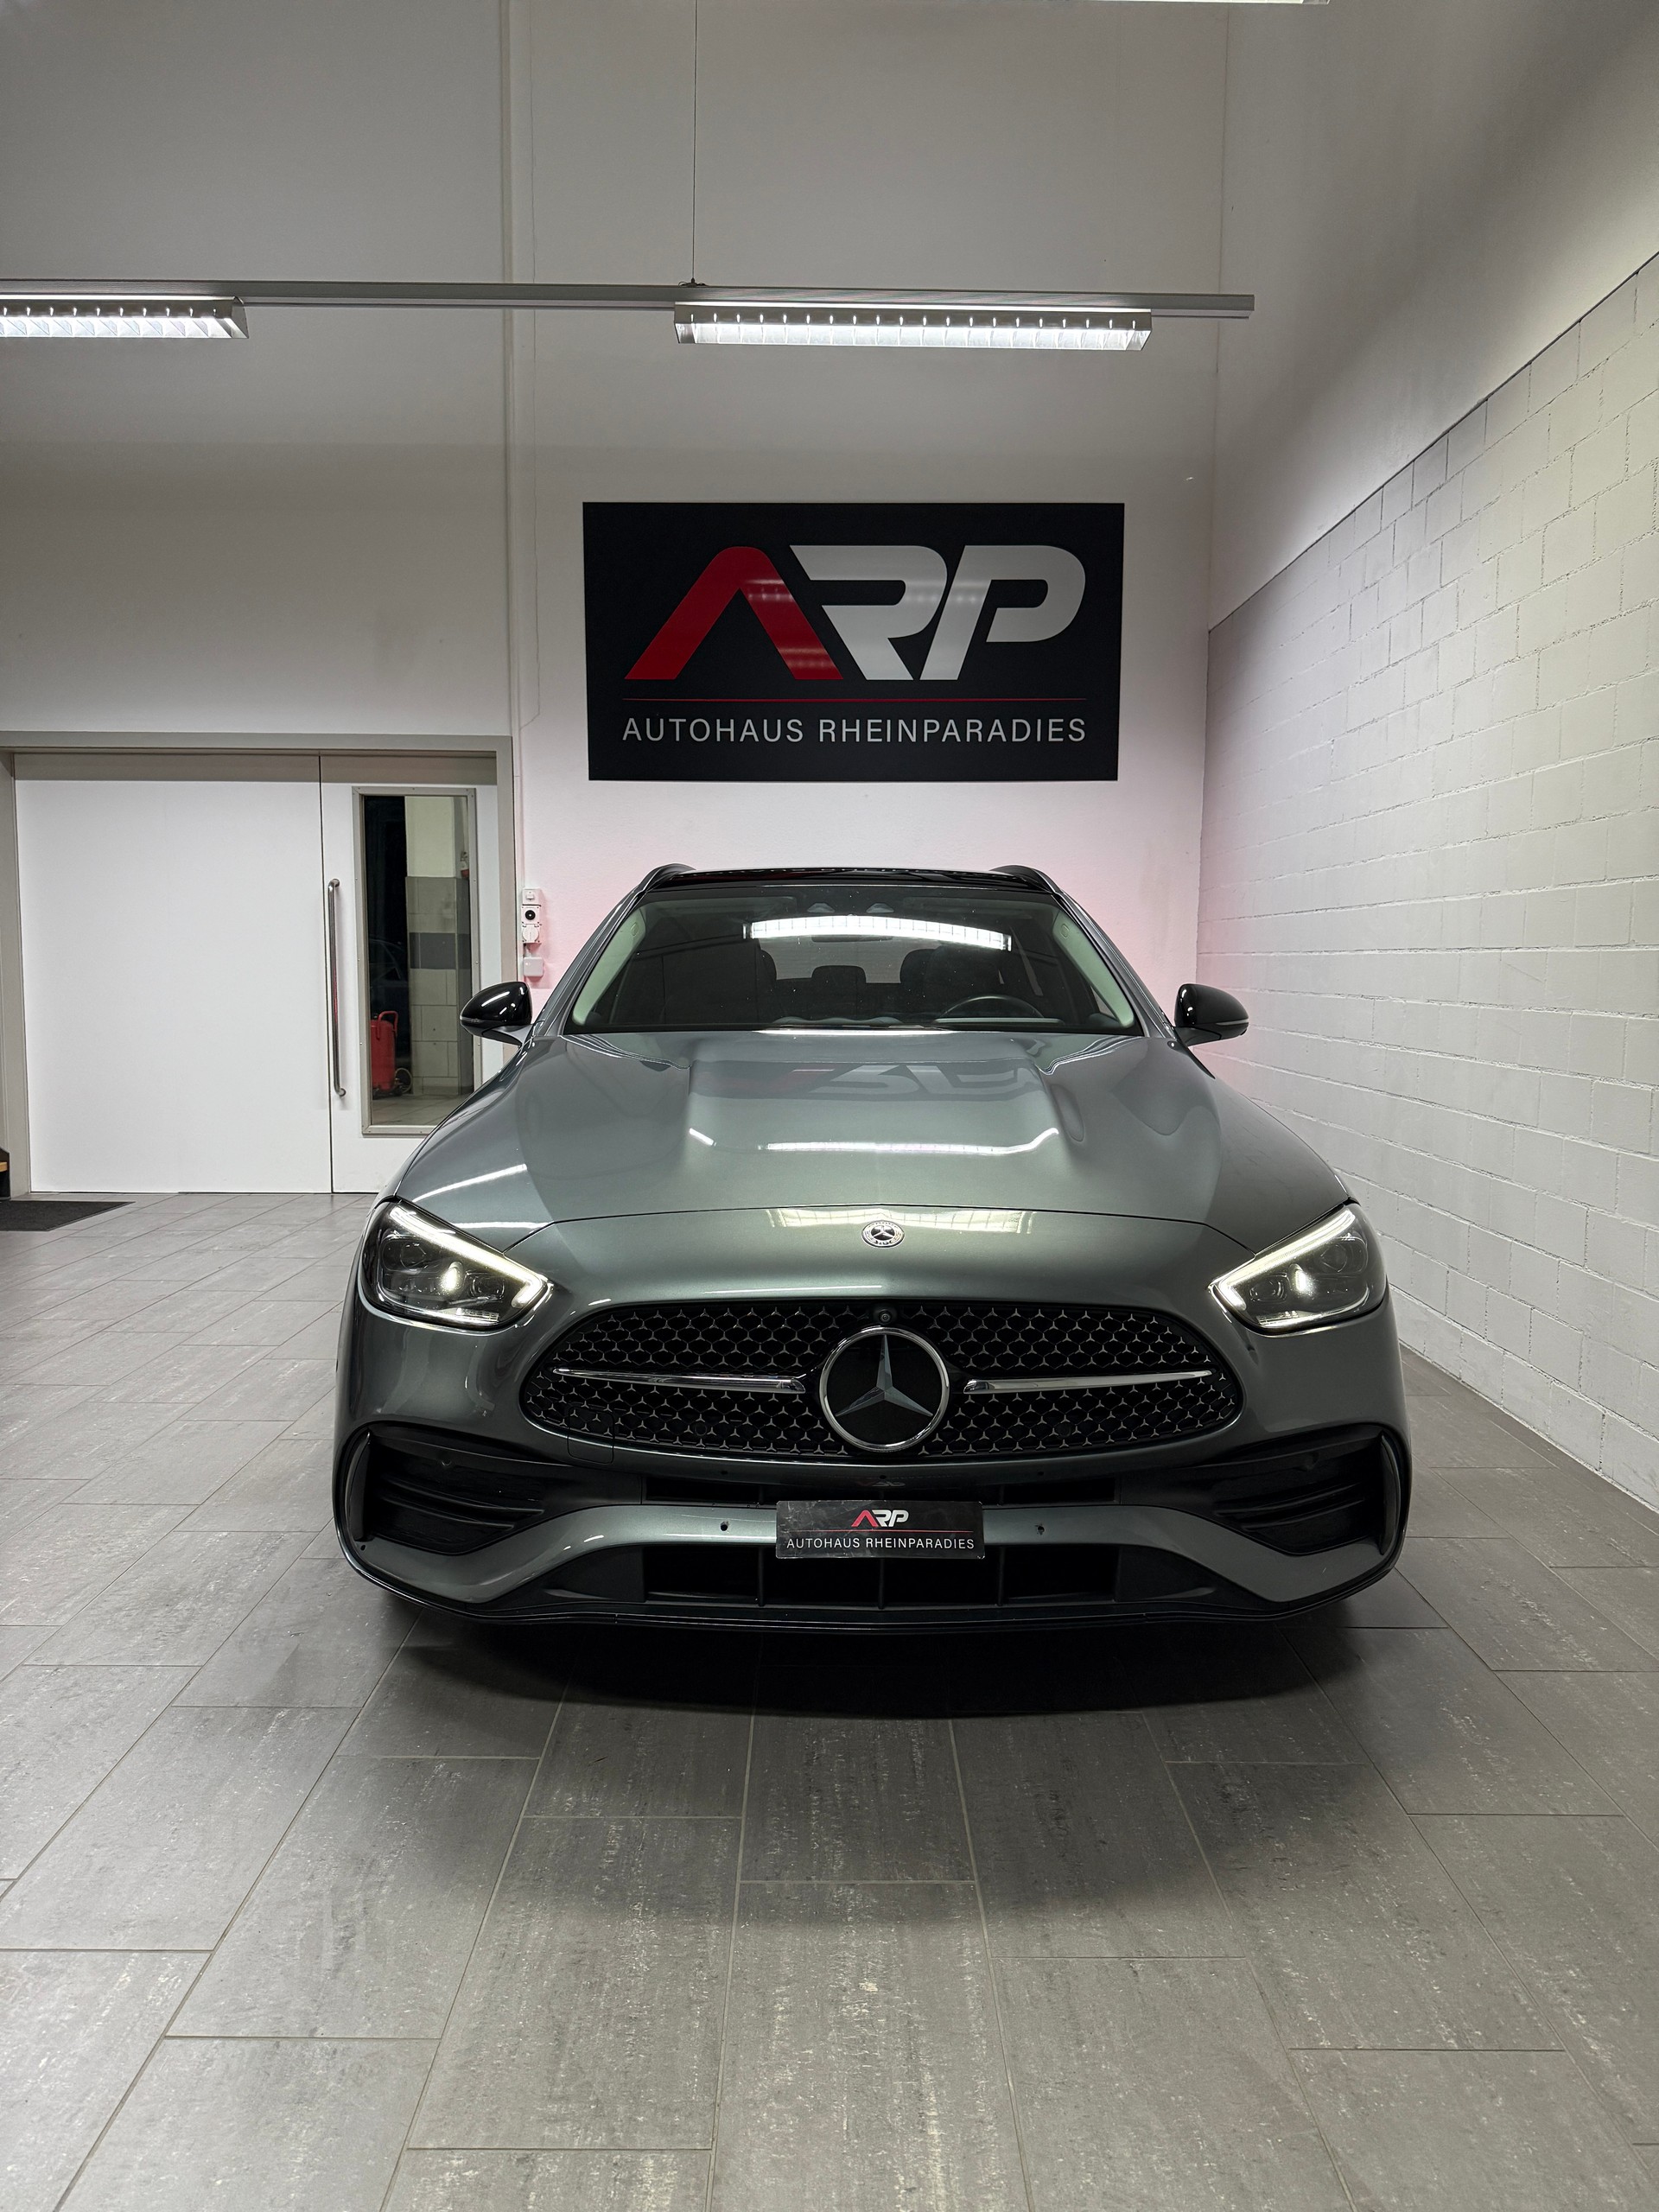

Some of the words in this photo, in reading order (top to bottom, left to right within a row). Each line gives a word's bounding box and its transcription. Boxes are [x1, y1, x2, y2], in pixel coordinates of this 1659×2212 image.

[624, 545, 1086, 680] ARP
[622, 718, 804, 742] AUTOHAUS
[819, 718, 1086, 743] RHEINPARADIES
[850, 1509, 910, 1528] ARP
[786, 1537, 861, 1549] AUTOHAUS
[866, 1537, 976, 1549] RHEINPARADIES
